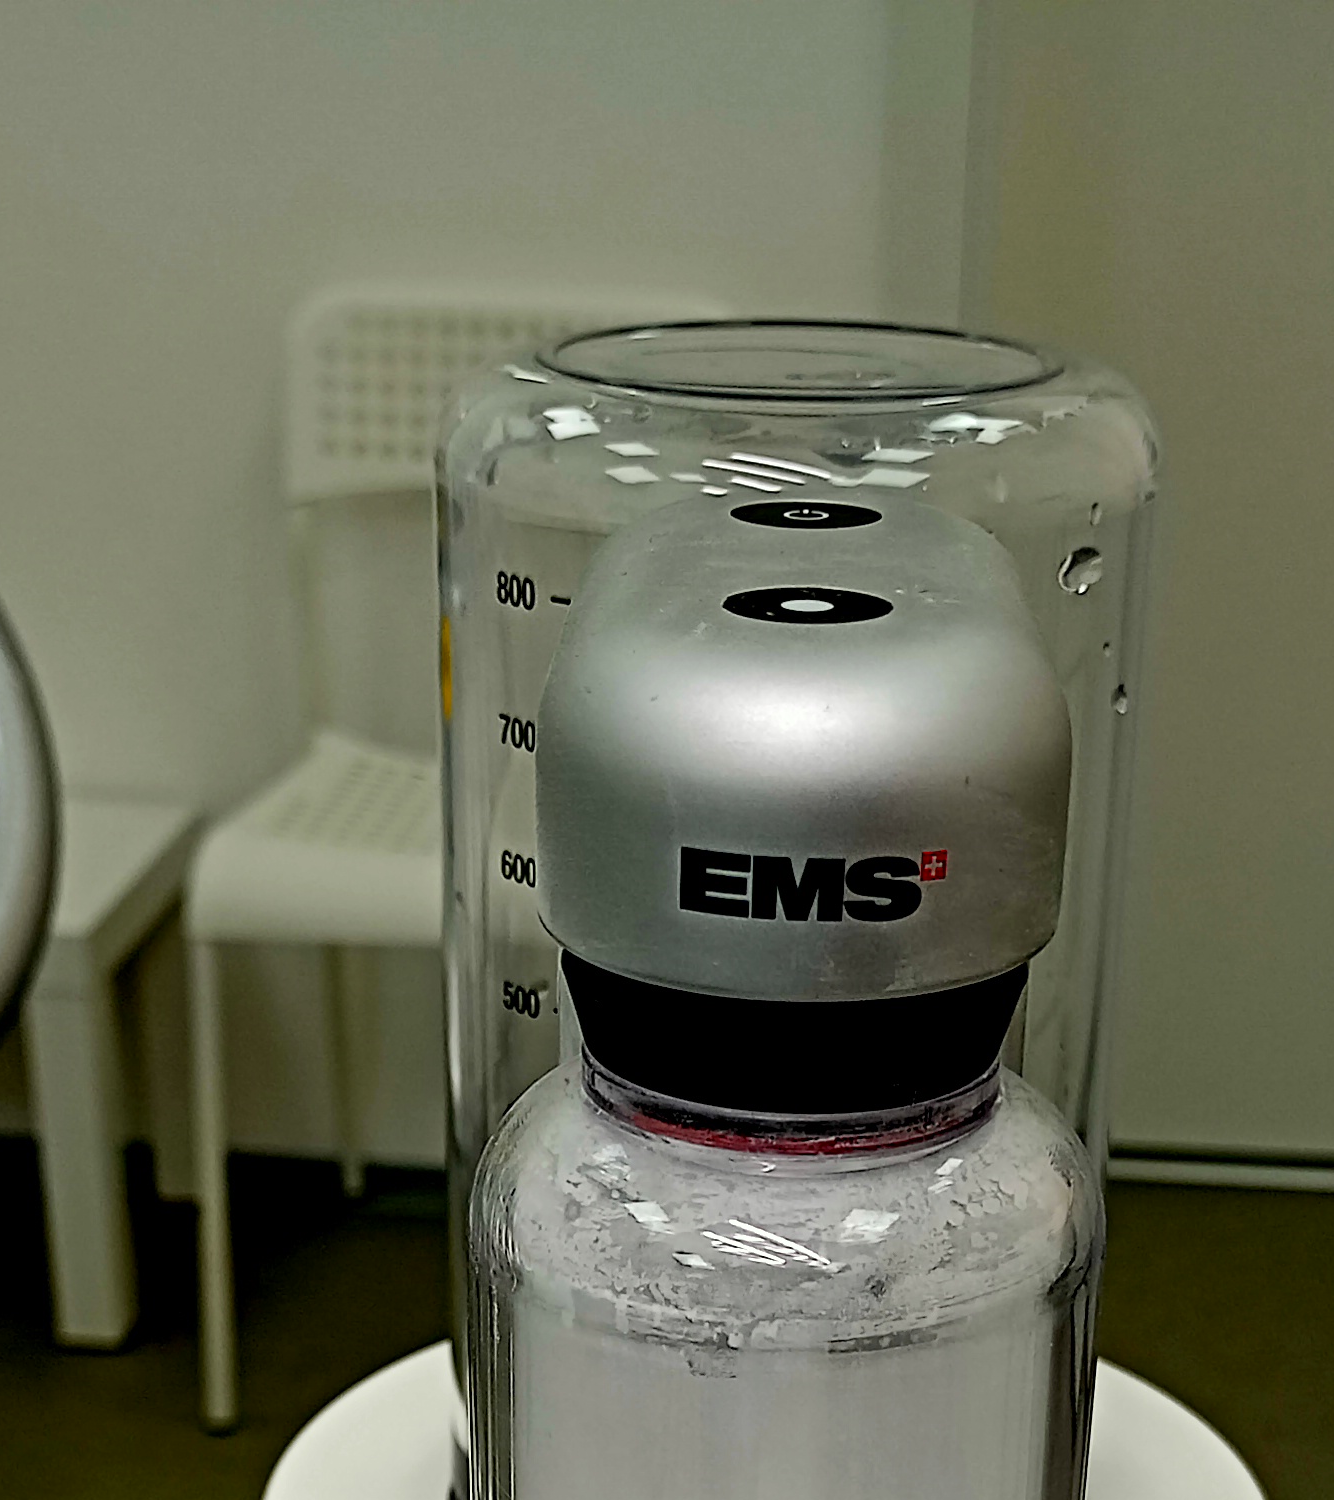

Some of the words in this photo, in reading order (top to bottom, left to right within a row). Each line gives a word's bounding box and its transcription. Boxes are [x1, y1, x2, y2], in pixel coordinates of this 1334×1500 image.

[497, 571, 536, 611] 800
[499, 713, 536, 753] 700
[501, 849, 537, 888] 600
[679, 845, 923, 922] EMS
[502, 981, 541, 1019] 500
